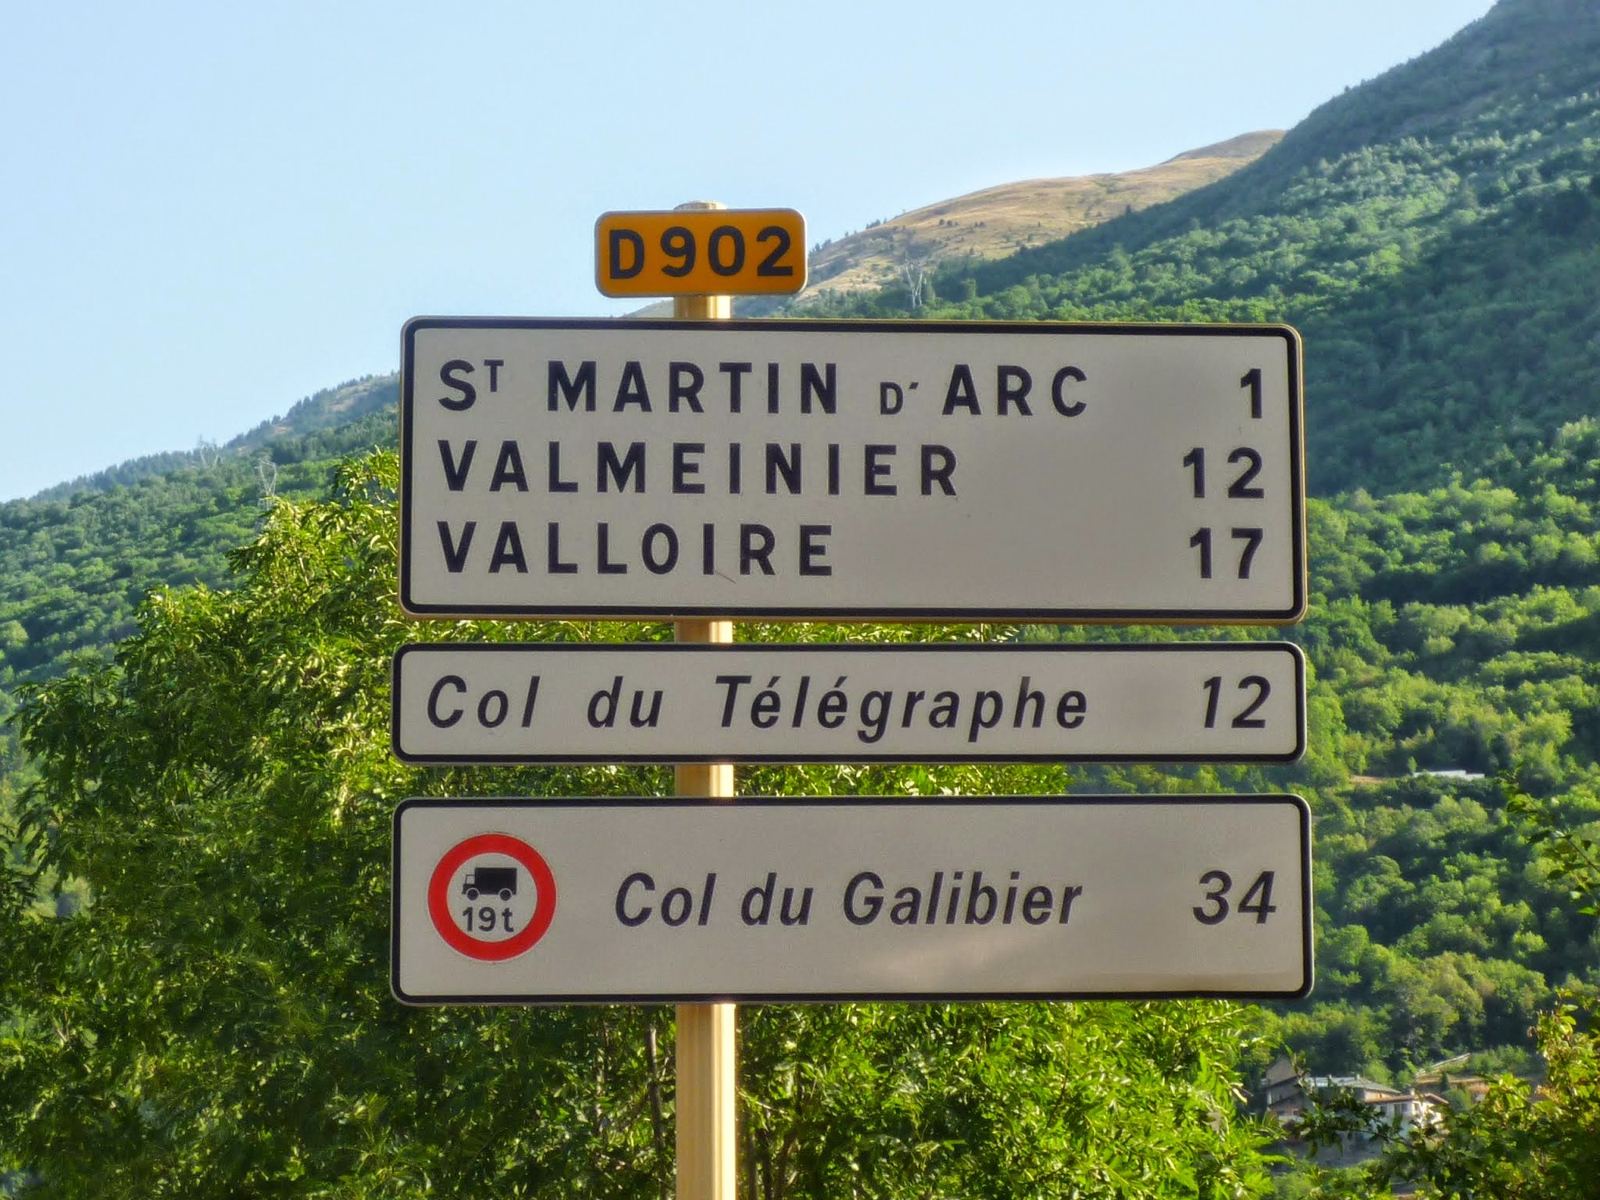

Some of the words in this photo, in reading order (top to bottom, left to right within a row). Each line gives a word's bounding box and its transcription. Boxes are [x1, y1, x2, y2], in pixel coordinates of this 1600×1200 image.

[547, 360, 837, 415] MARTIN
[1240, 368, 1262, 419] 1
[437, 439, 957, 496] VALMEINIER
[1183, 446, 1265, 499] 12
[436, 521, 832, 577] VALLOIRE
[1189, 527, 1264, 580] 17
[427, 674, 541, 729] Col
[587, 675, 664, 729] du
[715, 675, 1087, 744] Télégraphe
[1203, 675, 1271, 729] 12
[615, 872, 717, 928] Col
[740, 872, 814, 926] du
[843, 871, 1083, 926] Galibier
[1192, 869, 1277, 926] 34
